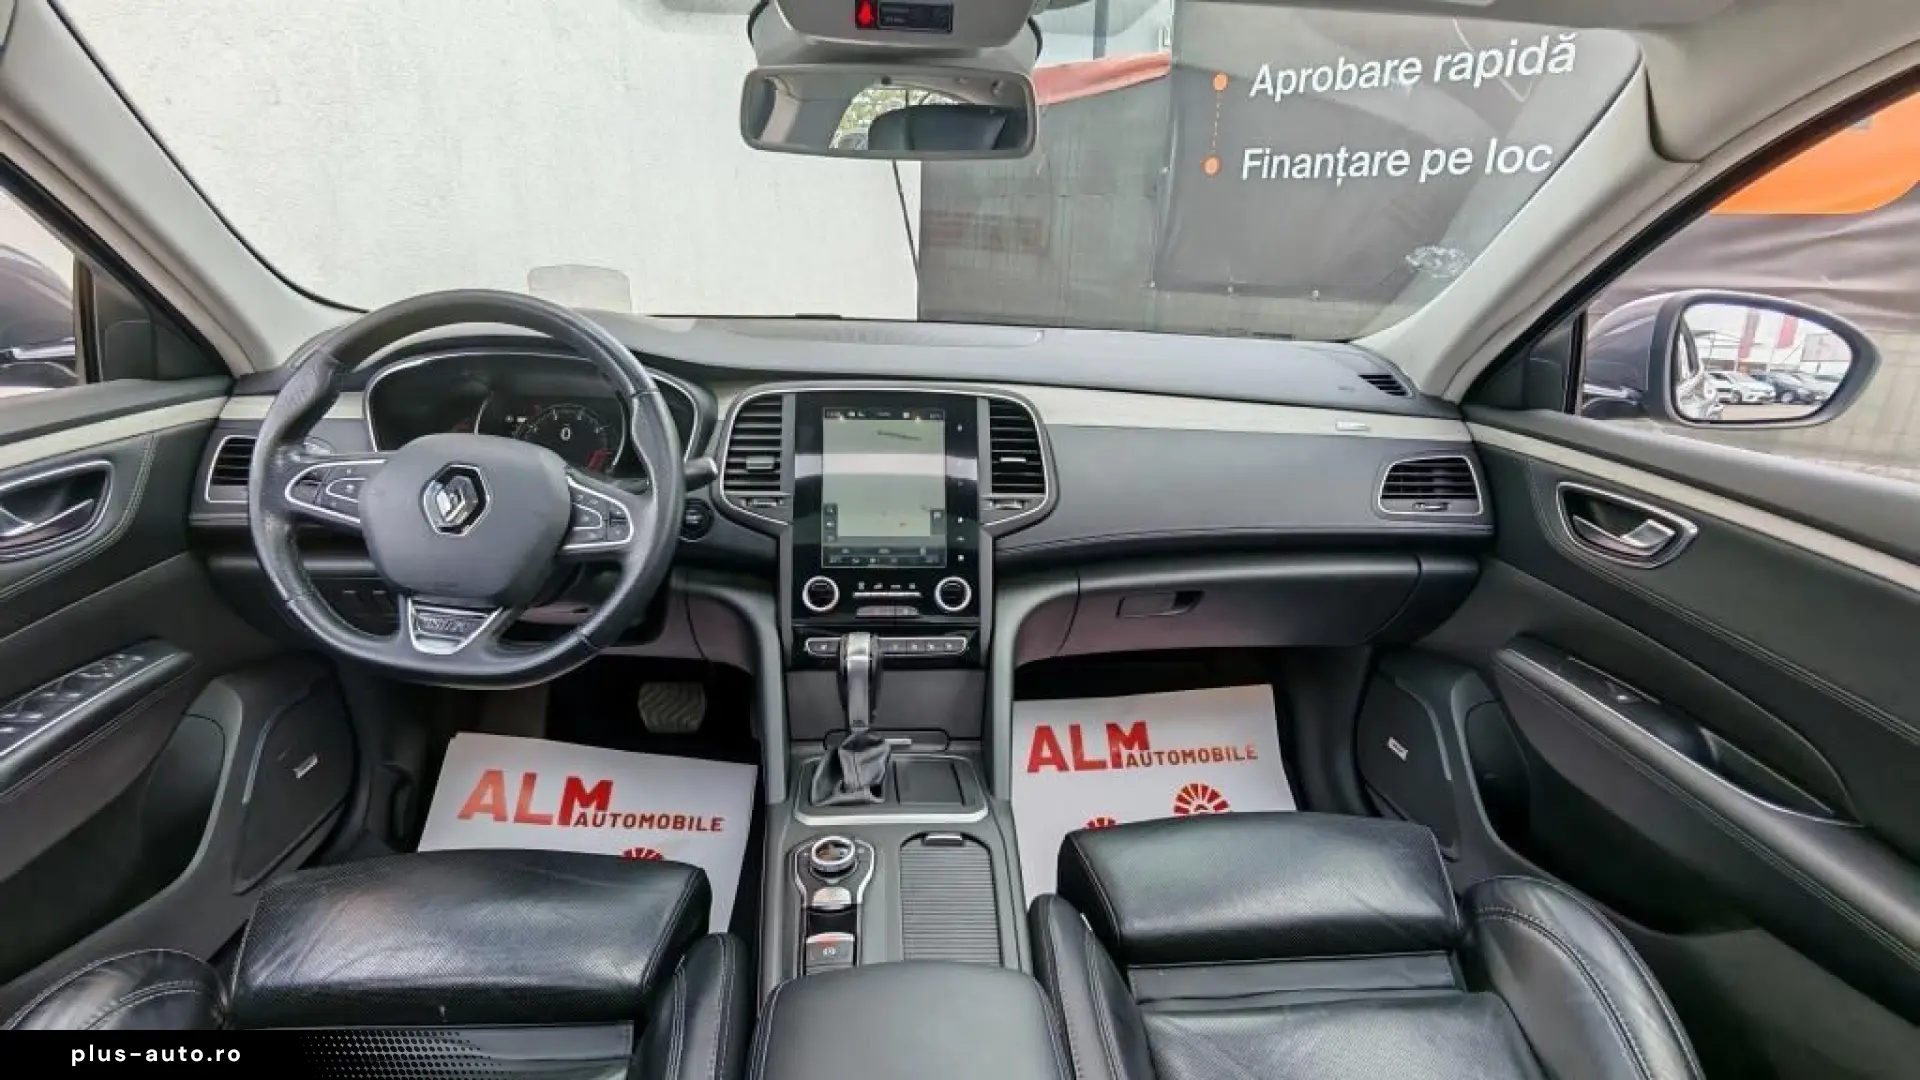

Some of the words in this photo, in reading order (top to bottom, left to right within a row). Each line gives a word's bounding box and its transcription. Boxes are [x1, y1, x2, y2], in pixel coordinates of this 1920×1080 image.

[1249, 57, 1423, 102] Aprobare
[1433, 33, 1577, 88] rapidă
[1241, 144, 1411, 187] Finanțare
[1419, 148, 1473, 182] pe
[1485, 138, 1553, 174] loc
[561, 427, 571, 441] 0
[1027, 720, 1150, 773] ALM
[1126, 743, 1258, 768] AUTOMOBILE
[457, 768, 614, 827] ALM
[573, 811, 724, 832] AUTOMOBILE
